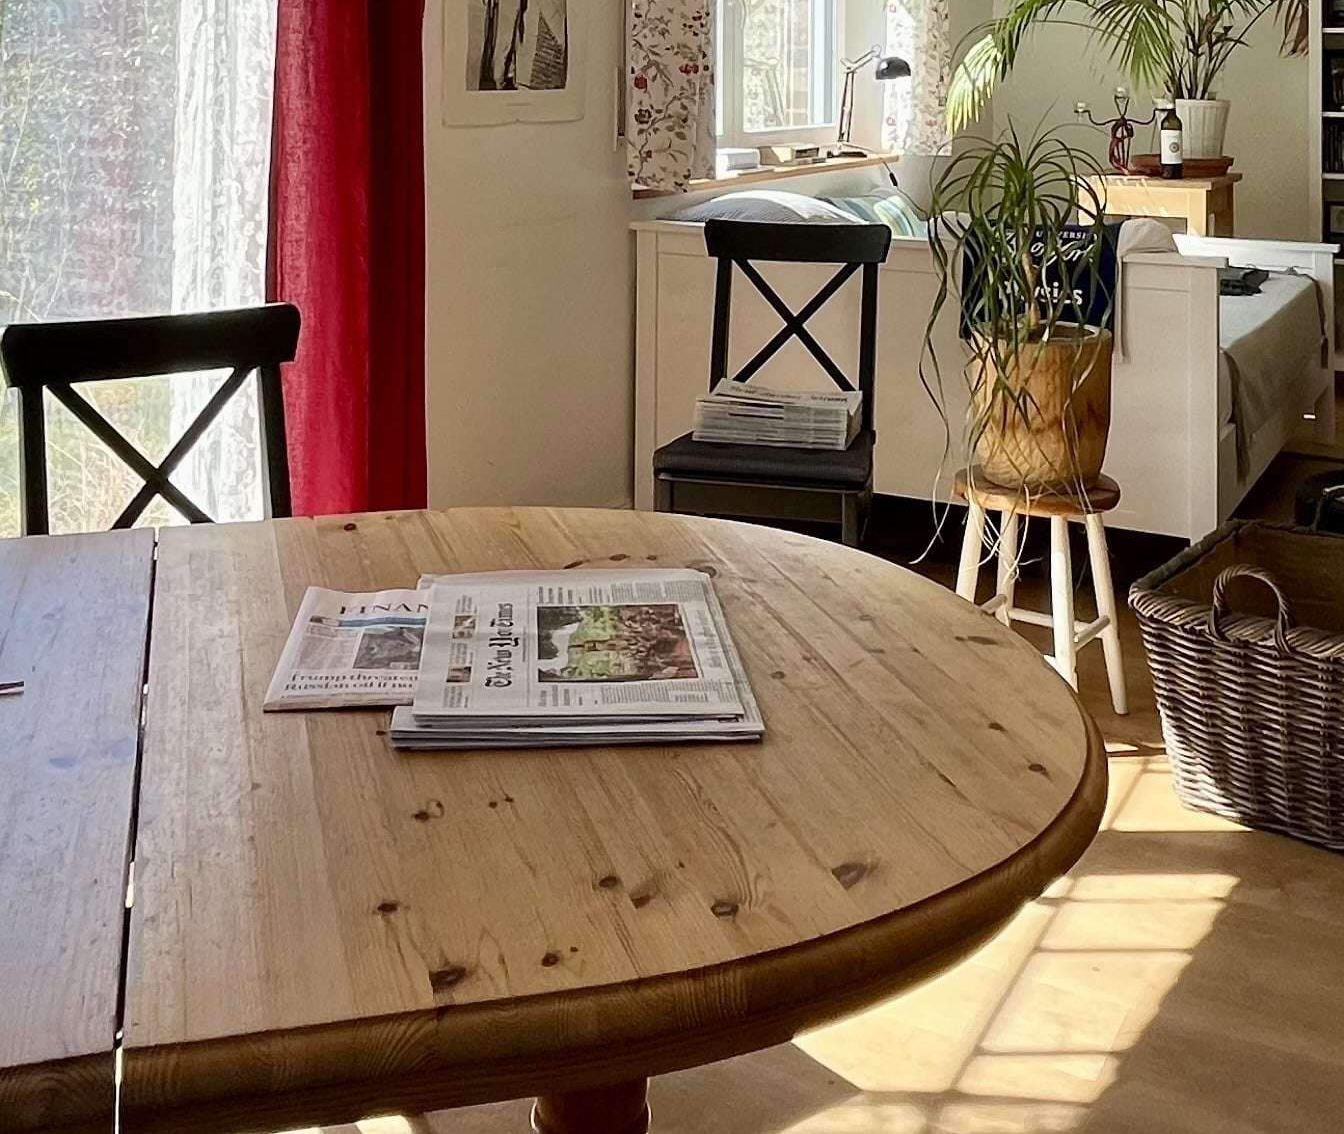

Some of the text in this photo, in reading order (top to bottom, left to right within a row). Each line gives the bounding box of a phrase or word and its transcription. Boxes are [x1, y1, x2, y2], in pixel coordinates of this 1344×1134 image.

[485, 602, 519, 688] The New Yor Times
